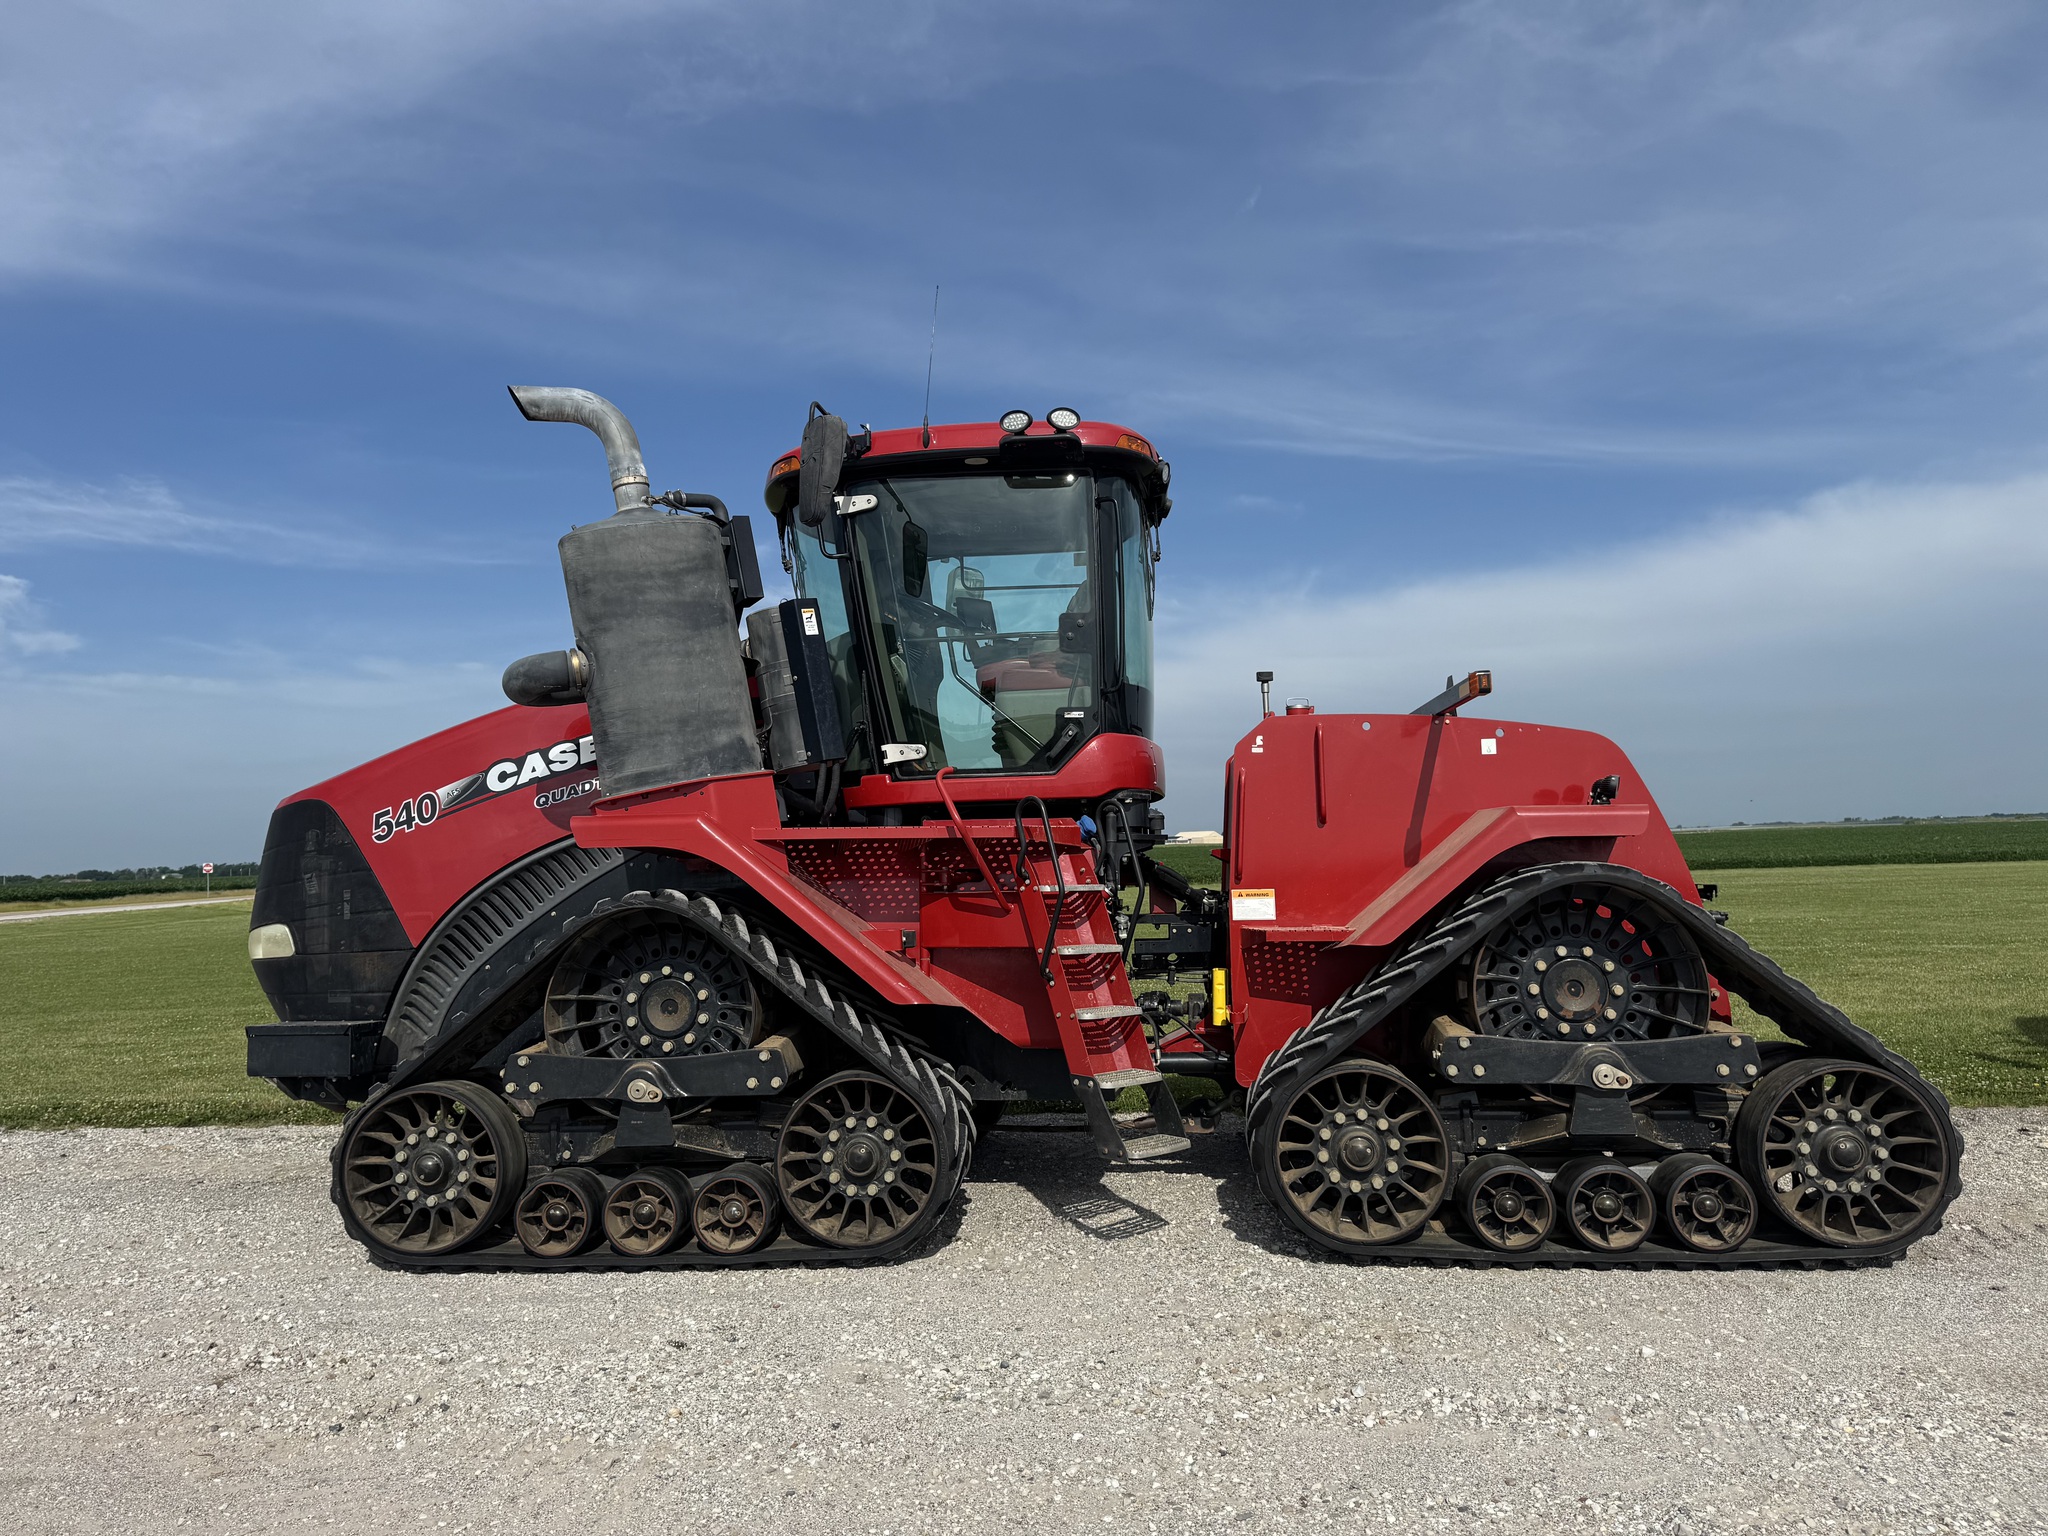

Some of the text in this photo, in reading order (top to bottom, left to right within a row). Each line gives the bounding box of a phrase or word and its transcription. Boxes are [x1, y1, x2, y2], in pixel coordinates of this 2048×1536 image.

[486, 735, 597, 792] CASE
[372, 791, 439, 843] 540
[446, 787, 461, 799] AFS
